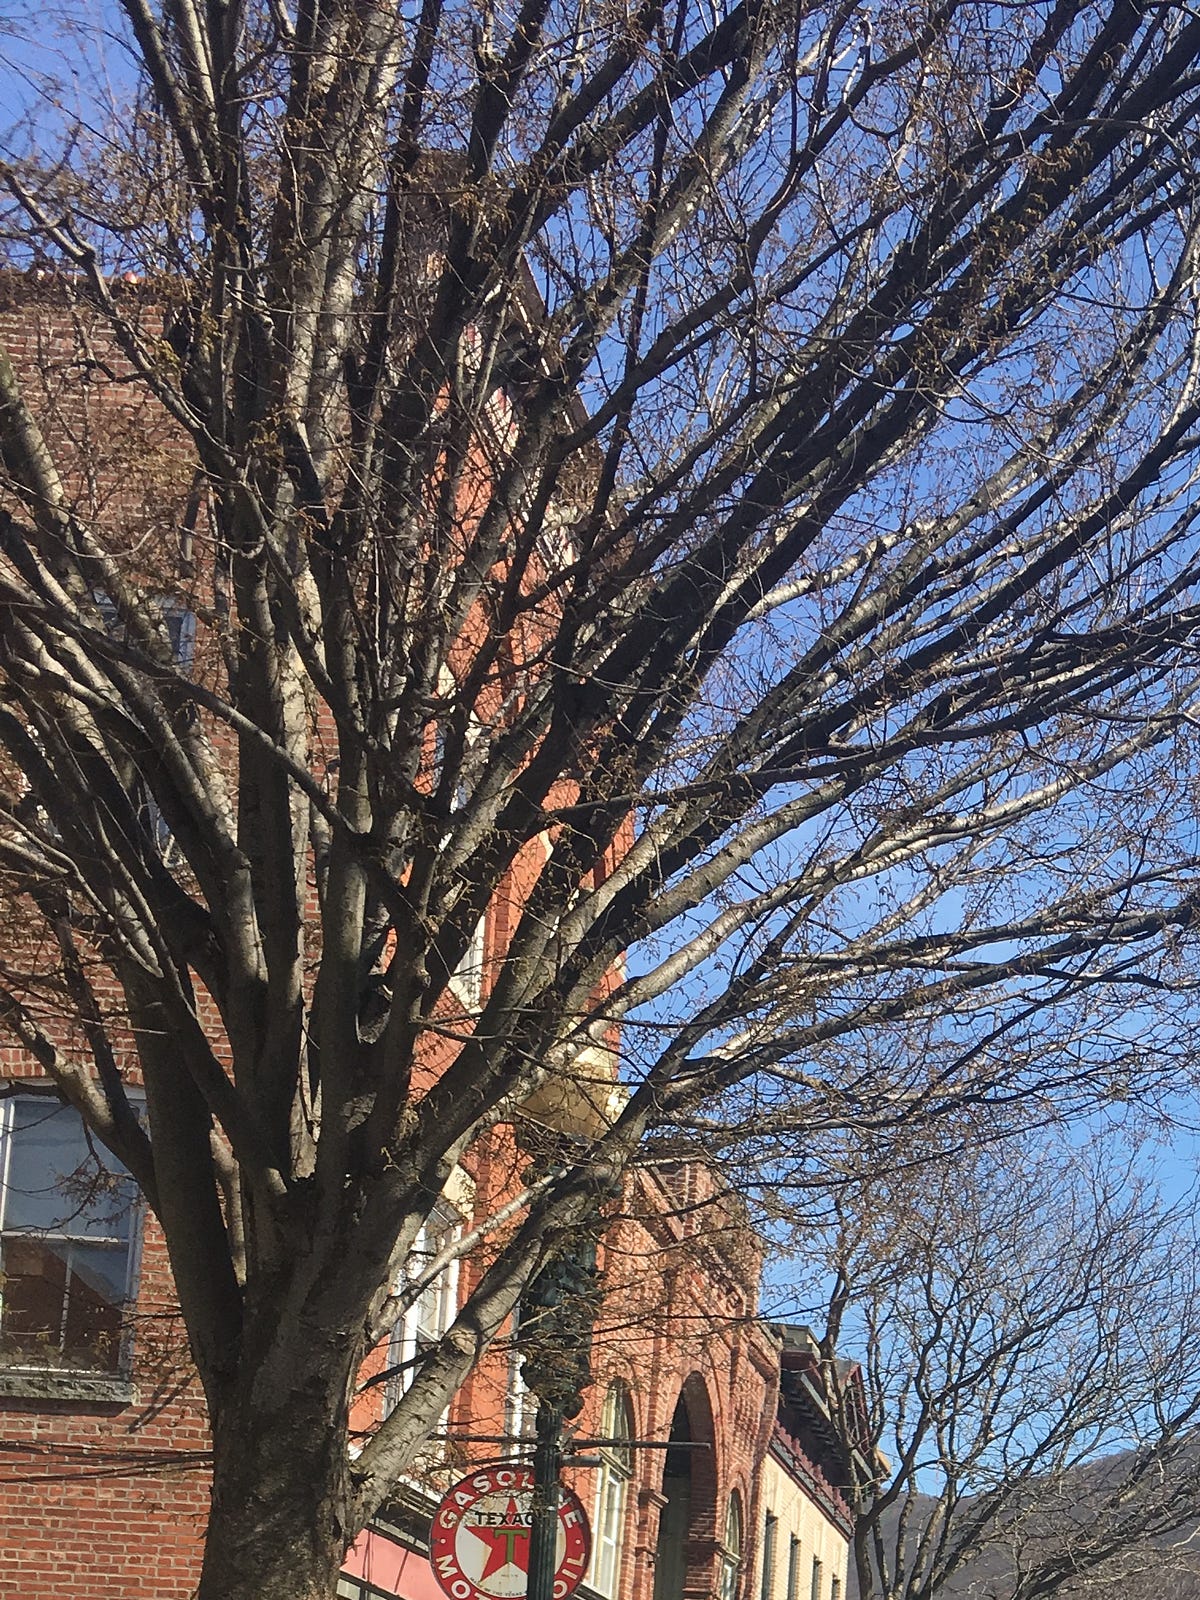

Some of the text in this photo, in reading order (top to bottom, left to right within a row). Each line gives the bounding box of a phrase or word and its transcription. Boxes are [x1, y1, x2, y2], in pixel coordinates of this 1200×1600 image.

[439, 1470, 584, 1529] GASOLNE
[475, 1512, 535, 1526] TEXAC
[553, 1552, 586, 1599] OIL
